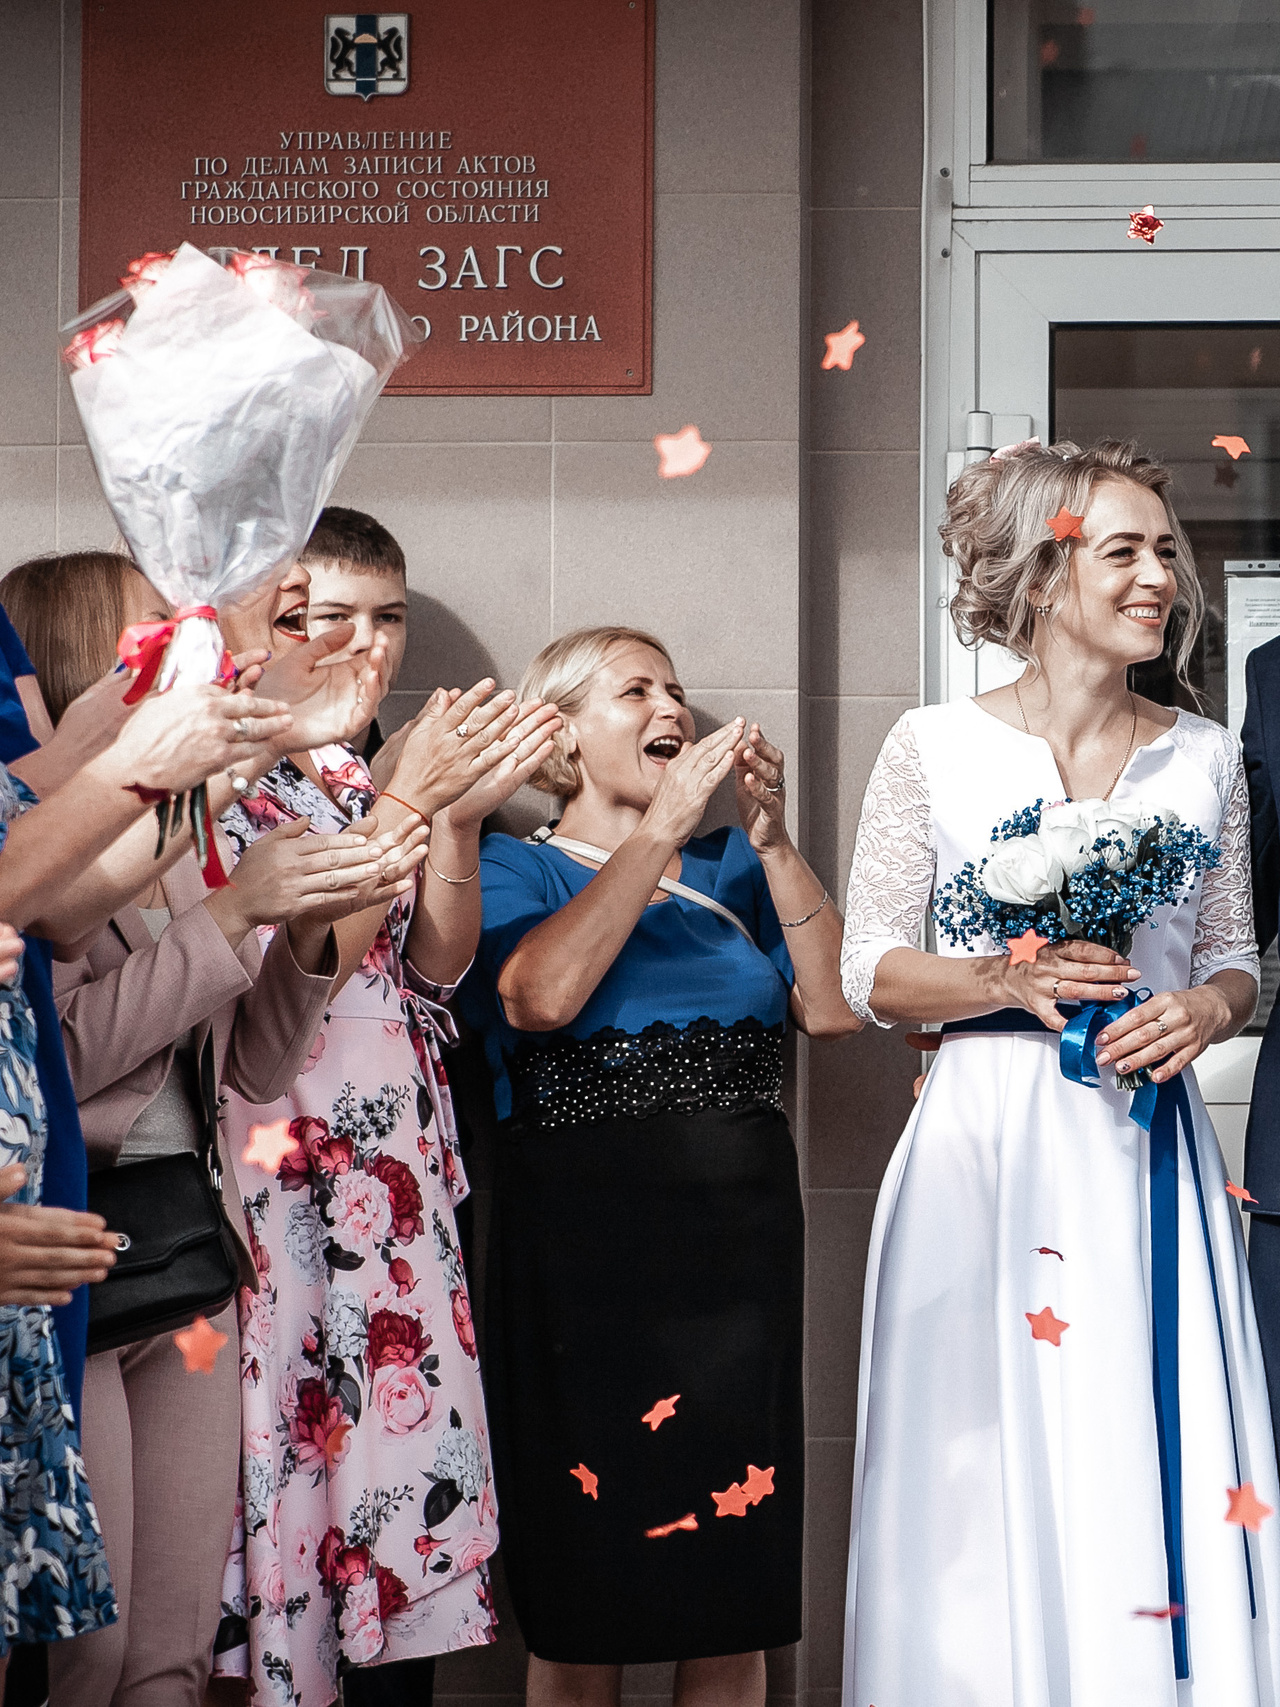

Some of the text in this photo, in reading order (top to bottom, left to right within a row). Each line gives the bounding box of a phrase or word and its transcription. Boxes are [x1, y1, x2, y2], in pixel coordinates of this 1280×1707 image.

[279, 131, 452, 150] УПРАВЛЕНИЕ
[194, 155, 537, 177] ПО ДЕЛАМ ЗАПИСИ АКТОВ
[180, 180, 550, 200] ГРАЖДАНСКОГО СОСТОЯНИЯ
[189, 201, 541, 225] НОВОСИБИРСКОЙ ОБЛАСТИ
[418, 246, 565, 290] ЗАГС
[459, 309, 602, 342] РАЙОНА
